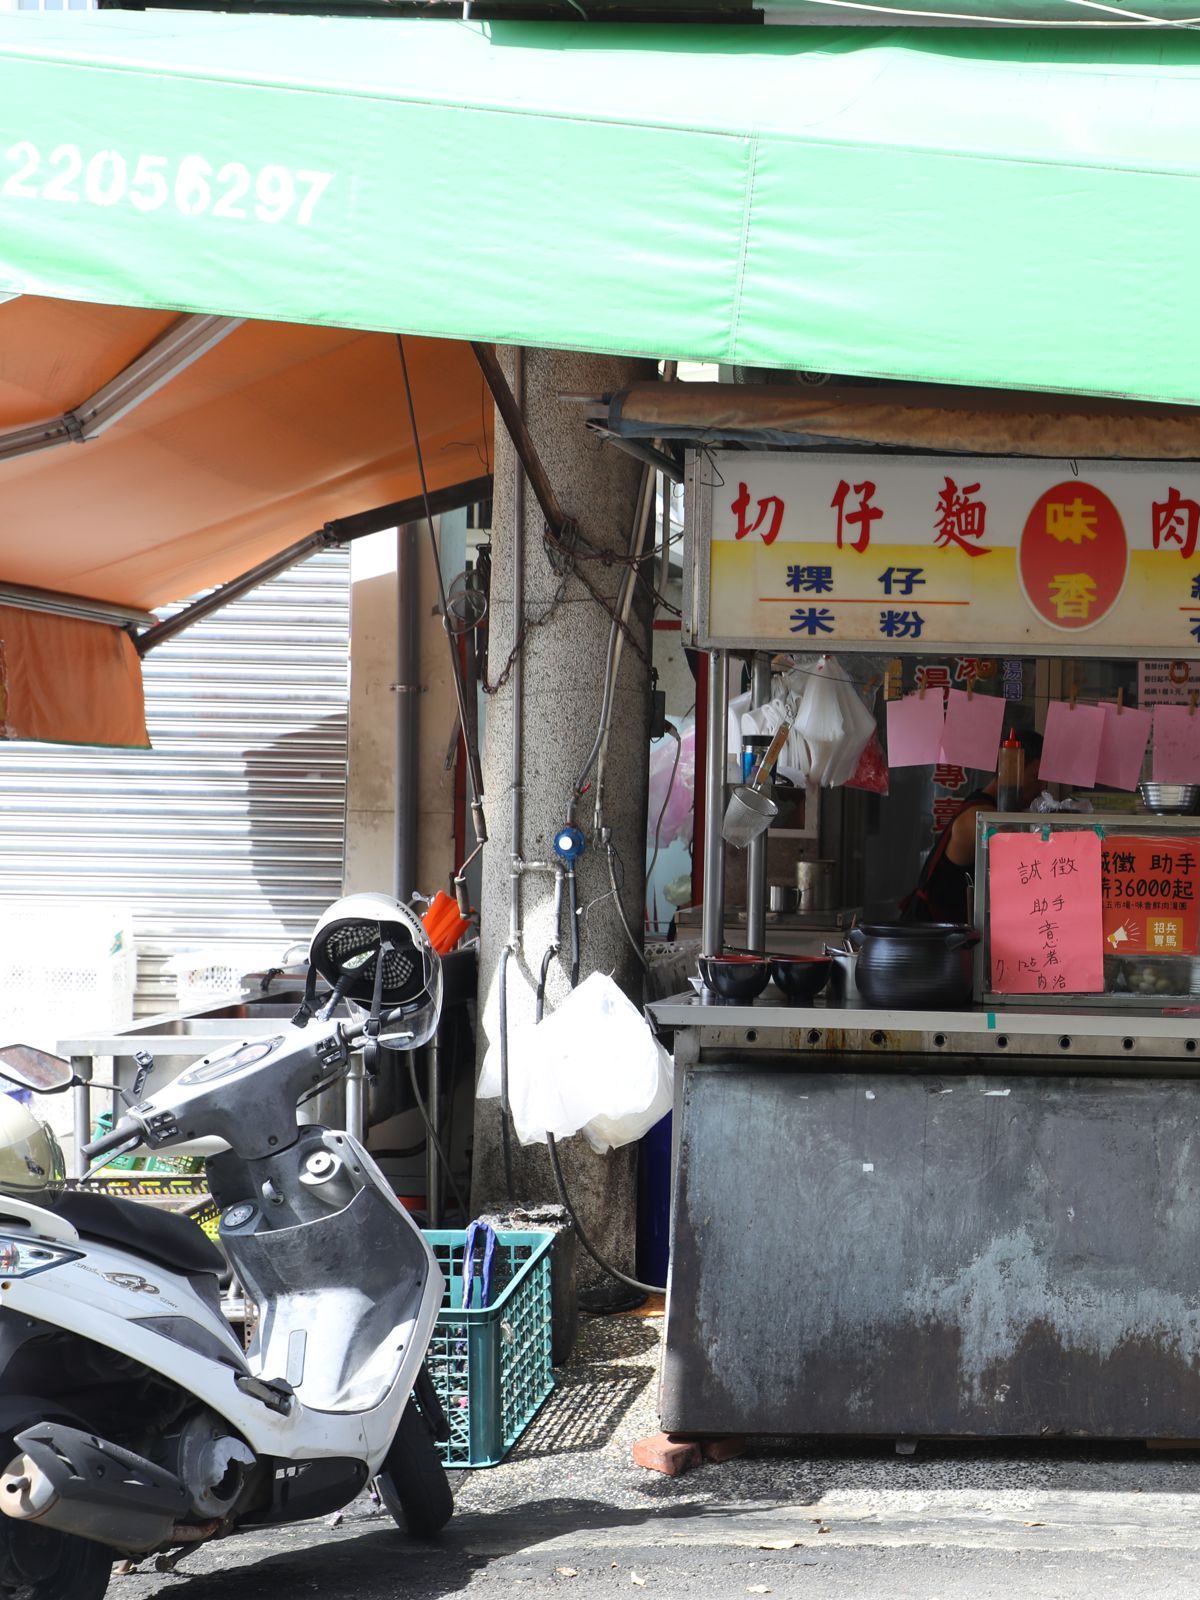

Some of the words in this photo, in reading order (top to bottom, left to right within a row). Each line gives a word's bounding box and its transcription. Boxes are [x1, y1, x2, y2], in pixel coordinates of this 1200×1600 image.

[1, 140, 336, 225] 22056297
[731, 476, 992, 558] 切仔麵
[786, 565, 927, 596] 粿仔
[1046, 497, 1099, 620] 味香
[789, 608, 926, 639] 米粉
[396, 903, 422, 934] YAMAHA
